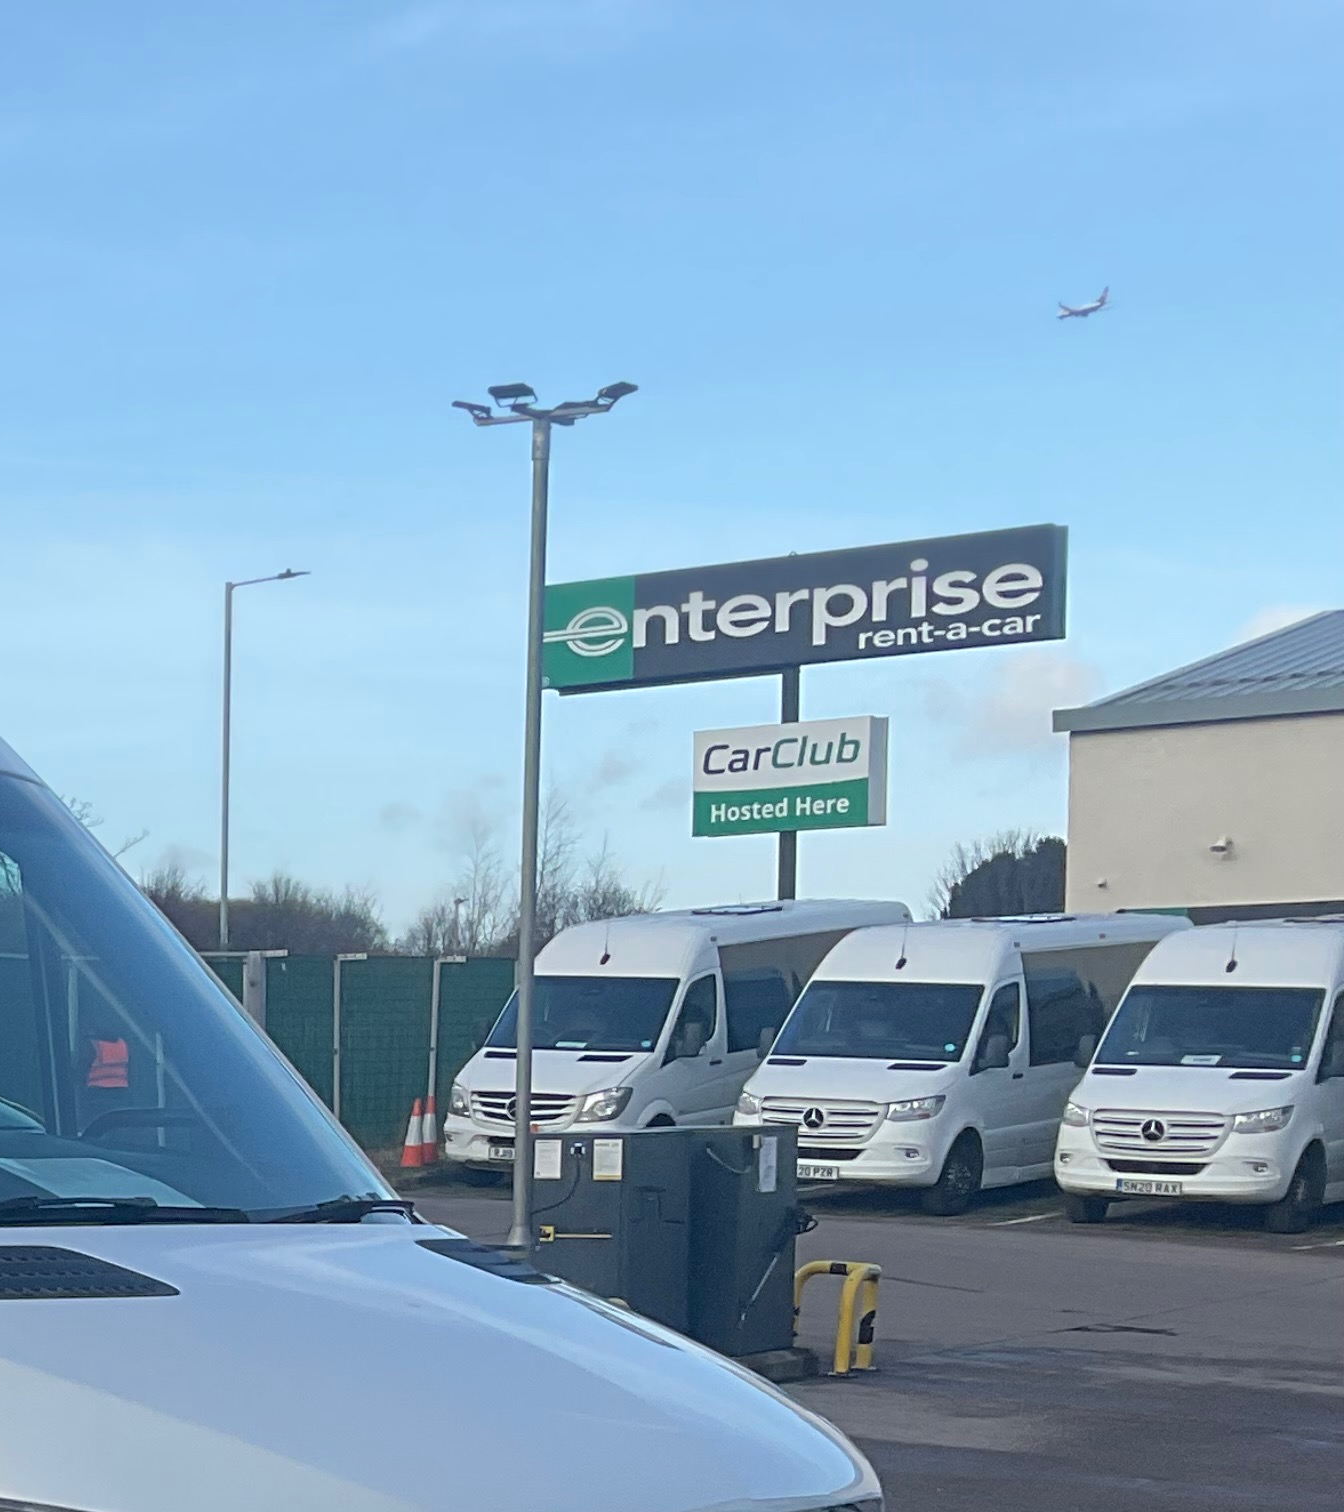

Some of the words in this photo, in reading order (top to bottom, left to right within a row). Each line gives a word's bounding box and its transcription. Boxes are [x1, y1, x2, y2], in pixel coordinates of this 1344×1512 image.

[544, 558, 1044, 658] enterprise
[858, 613, 1041, 650] rent-a-car
[702, 732, 861, 776] CarClub
[710, 797, 788, 823] Hosted
[795, 796, 850, 817] Here
